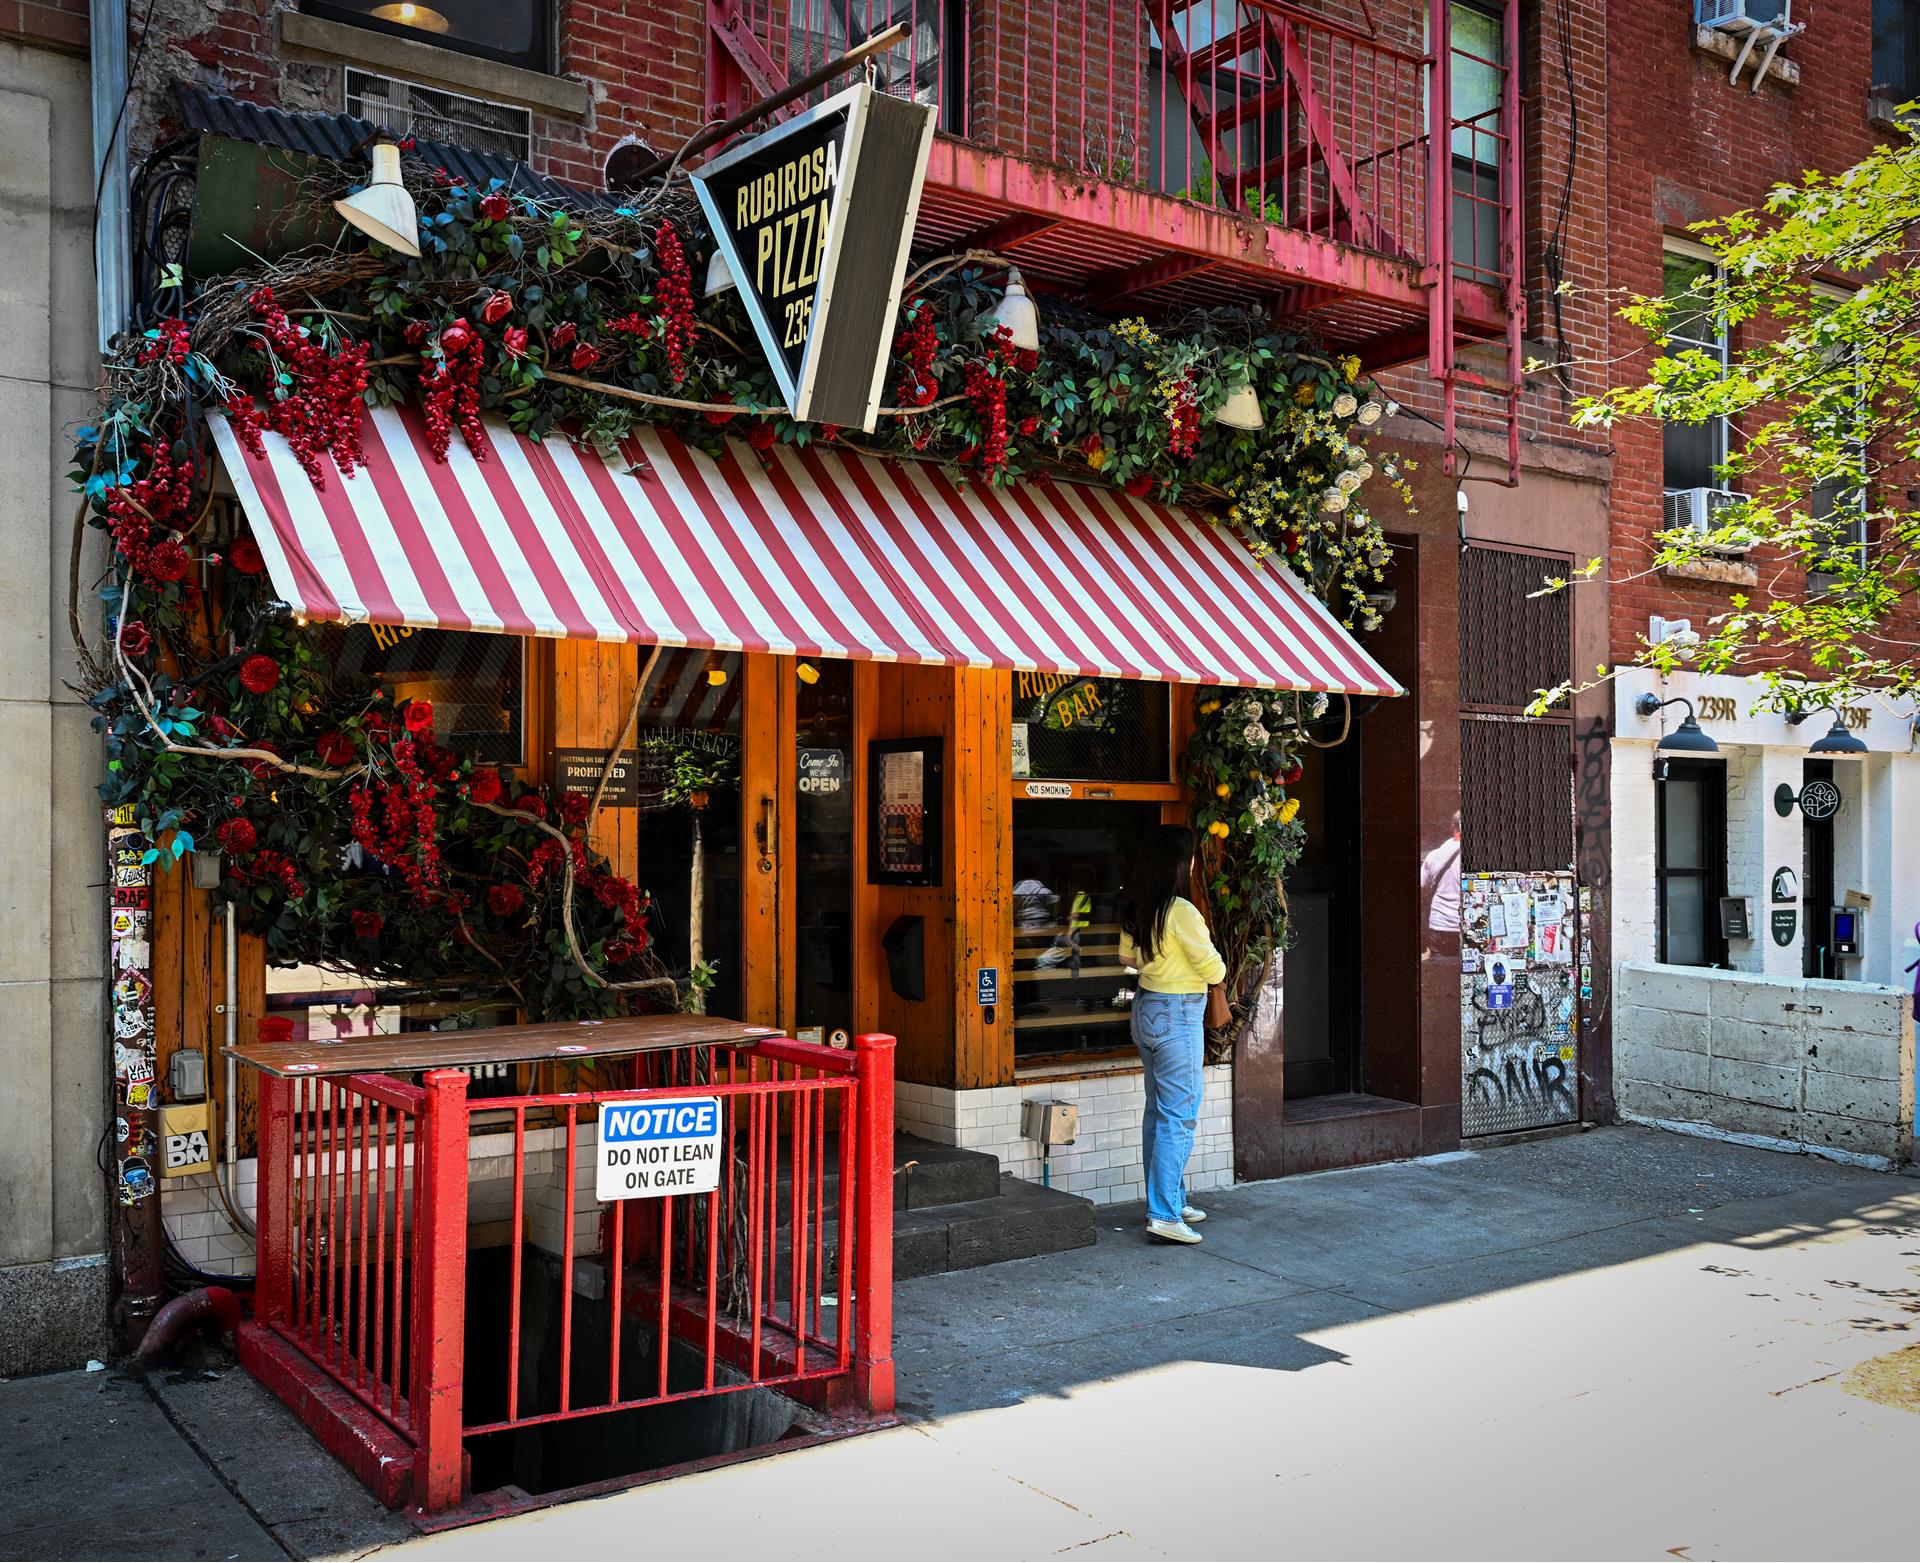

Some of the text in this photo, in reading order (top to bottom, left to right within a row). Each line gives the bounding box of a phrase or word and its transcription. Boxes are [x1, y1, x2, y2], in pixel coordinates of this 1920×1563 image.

[737, 140, 837, 231] RUBIROSA
[757, 198, 830, 299] PIZZA
[784, 295, 814, 349] 235
[1056, 683, 1103, 728] BAR
[1697, 695, 1738, 721] 239R
[1838, 705, 1872, 729] 239F
[800, 753, 839, 769] Come In
[799, 777, 840, 792] OPEN
[1029, 786, 1070, 796] NO SMOKING
[129, 1062, 153, 1073] VAN
[129, 1069, 153, 1081] CITY
[608, 1106, 715, 1137] NOTICE
[168, 1131, 209, 1151] DA
[168, 1147, 210, 1169] DM
[607, 1143, 714, 1167] DO NOT LEAN
[625, 1168, 696, 1189] ON GATE
